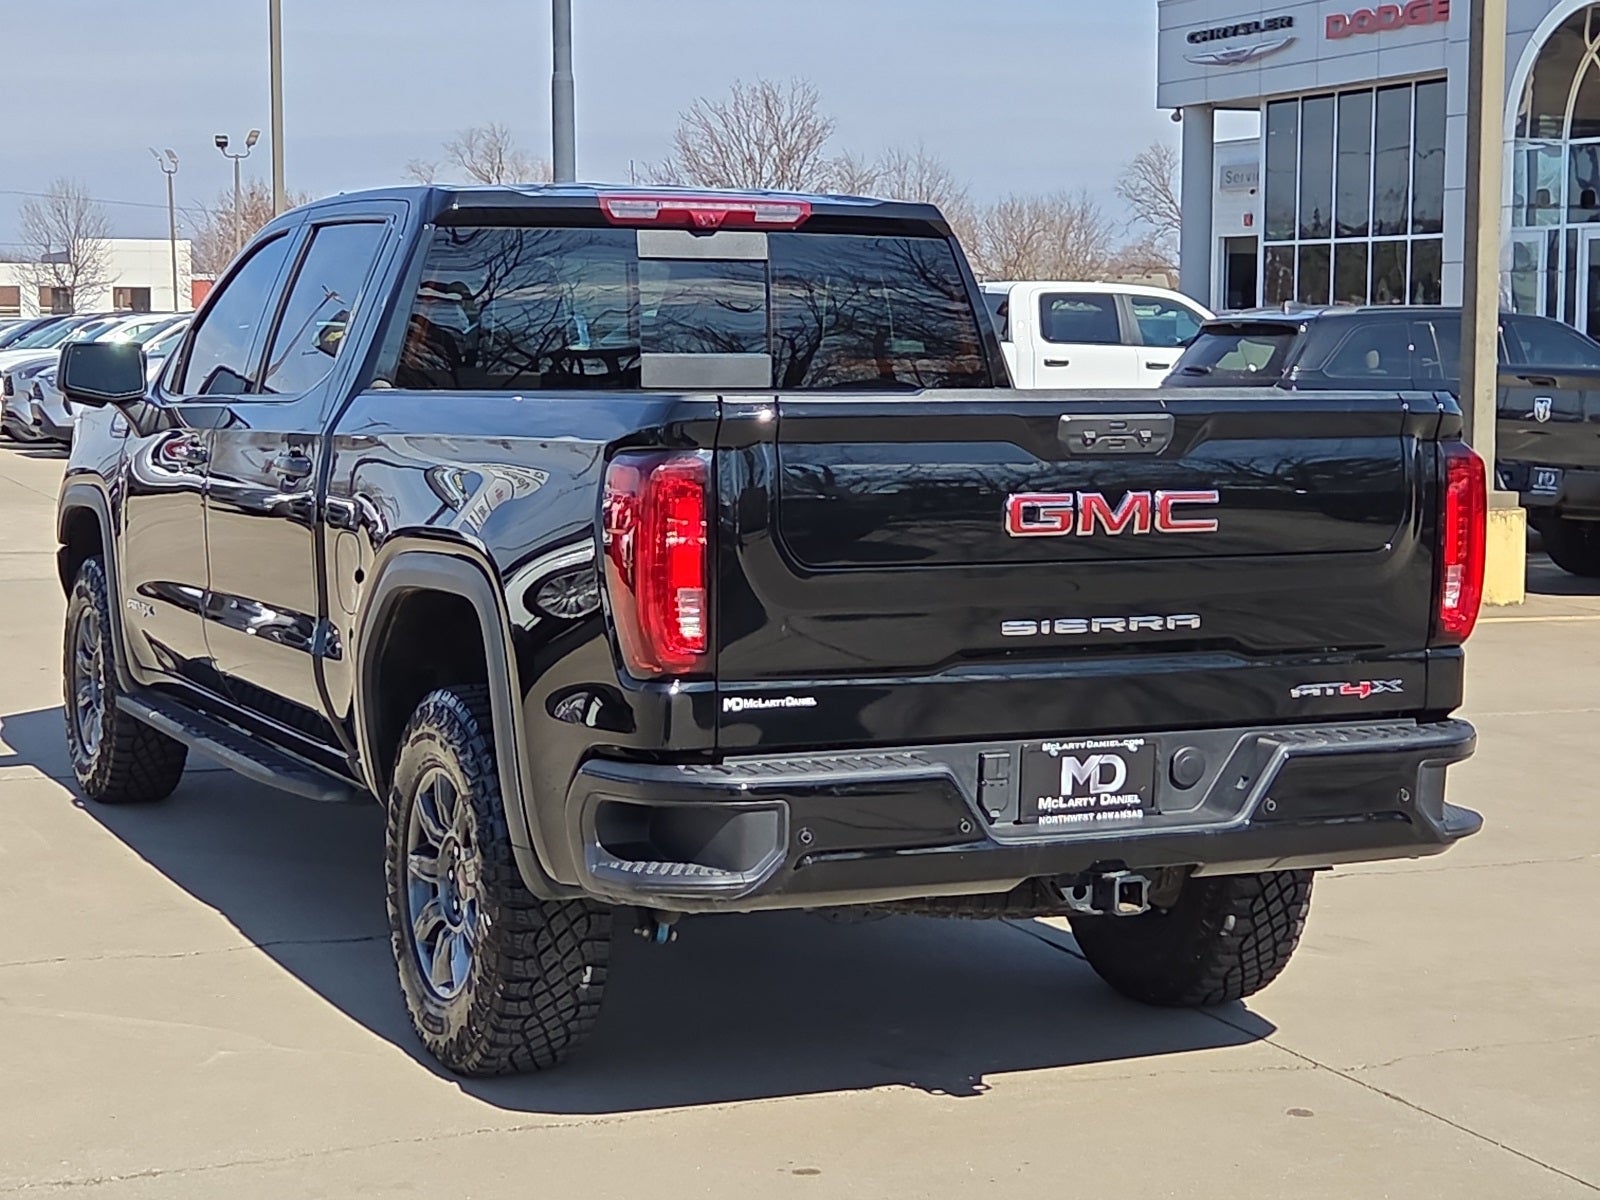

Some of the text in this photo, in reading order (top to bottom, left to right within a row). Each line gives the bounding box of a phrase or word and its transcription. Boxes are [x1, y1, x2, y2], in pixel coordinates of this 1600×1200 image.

[1187, 15, 1294, 44] CHRYSLER
[1325, 0, 1449, 40] DODGE
[1225, 170, 1259, 184] Servi
[1005, 490, 1219, 537] GMC
[1001, 614, 1201, 636] SIERRA
[1290, 679, 1404, 699] AT4X
[1060, 753, 1127, 796] MD
[1100, 793, 1142, 807] DANIEL
[1038, 808, 1144, 825] NORTHWEST ARKANSAS
